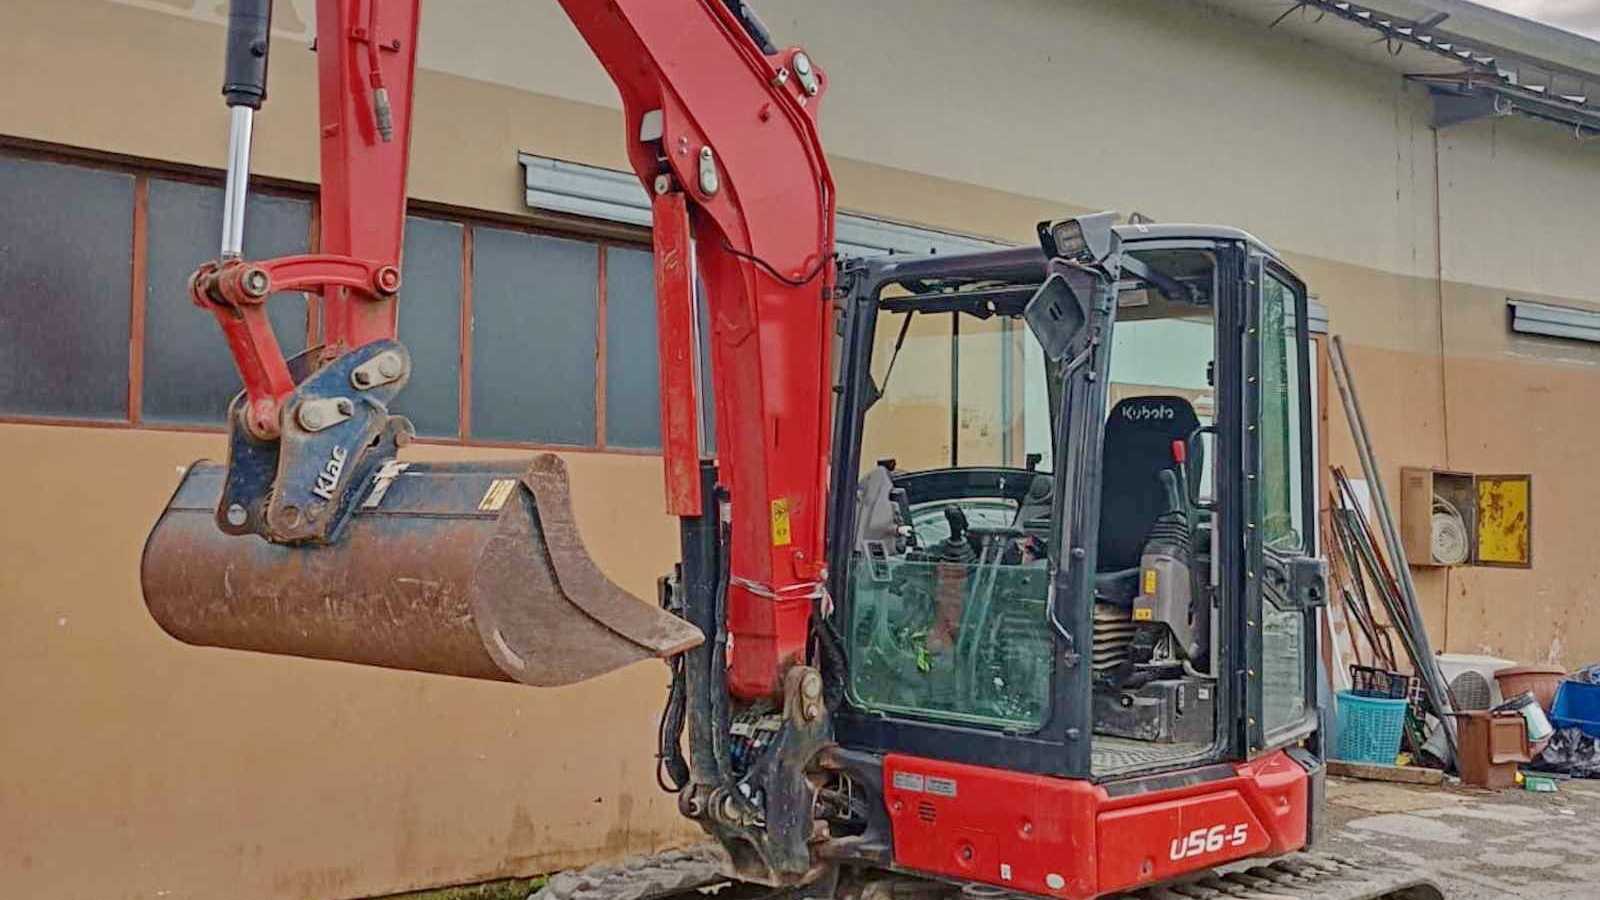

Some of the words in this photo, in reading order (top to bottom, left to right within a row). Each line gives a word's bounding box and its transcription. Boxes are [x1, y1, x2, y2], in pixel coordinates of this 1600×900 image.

[1122, 404, 1174, 420] Kubota
[312, 445, 348, 500] Klac
[1170, 823, 1248, 861] U56-5
